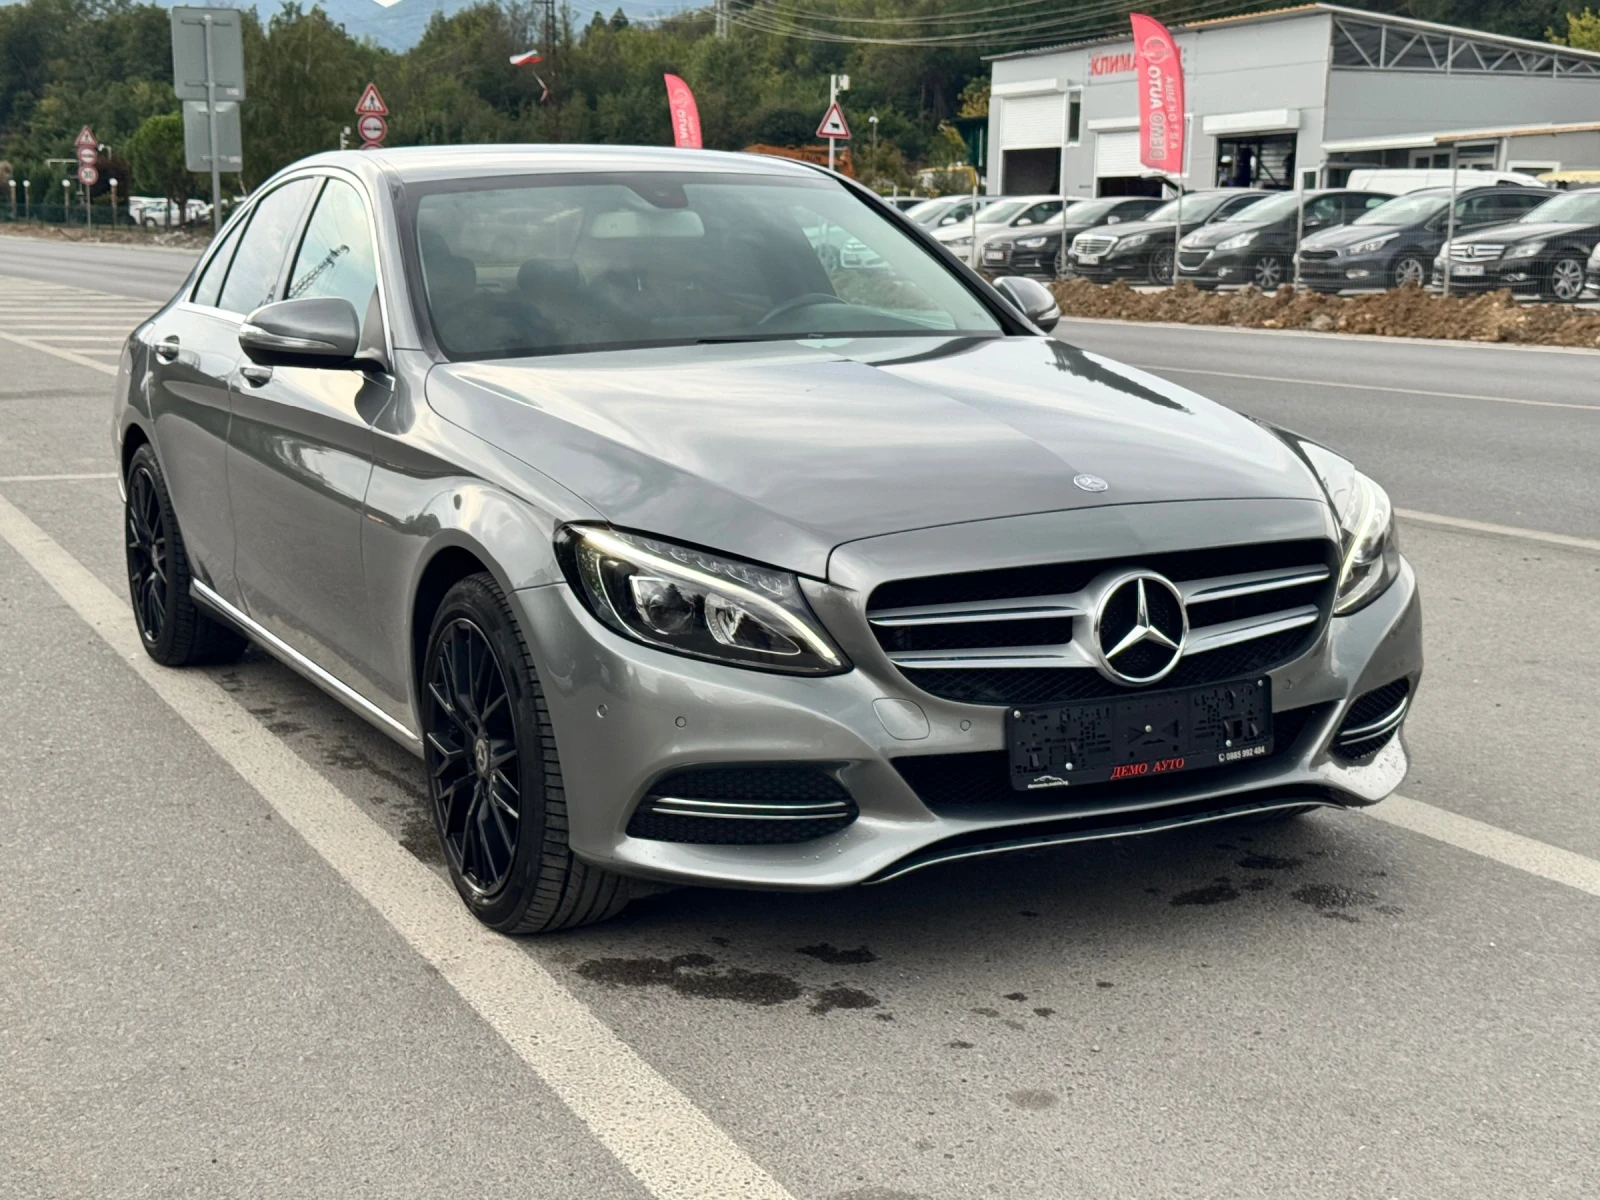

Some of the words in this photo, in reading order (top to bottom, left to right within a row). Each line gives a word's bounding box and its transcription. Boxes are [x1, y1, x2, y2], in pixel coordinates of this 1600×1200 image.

[1242, 748, 1253, 758] 992
[1110, 763, 1148, 780] ДЕМО
[1152, 757, 1185, 772] АУТО
